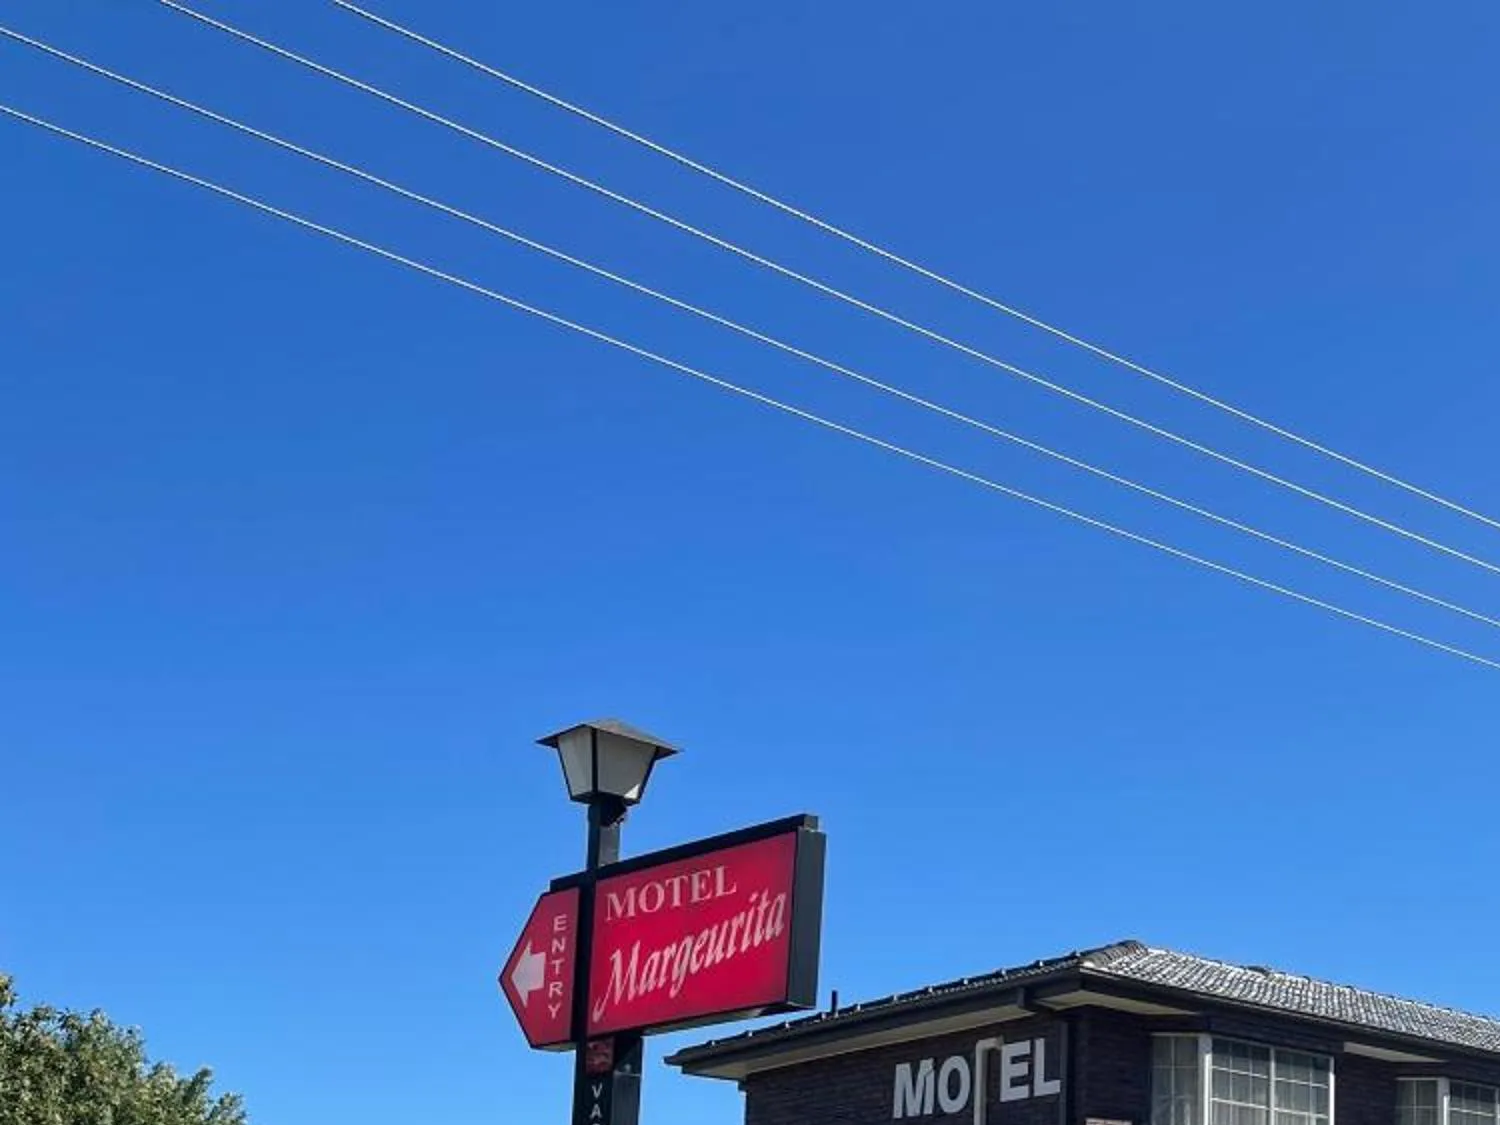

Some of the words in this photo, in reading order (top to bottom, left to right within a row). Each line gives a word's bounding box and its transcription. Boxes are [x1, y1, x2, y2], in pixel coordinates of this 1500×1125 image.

[606, 865, 738, 923] MOTEL
[548, 914, 569, 1020] ENTRY
[893, 1037, 1062, 1119] MOEL
